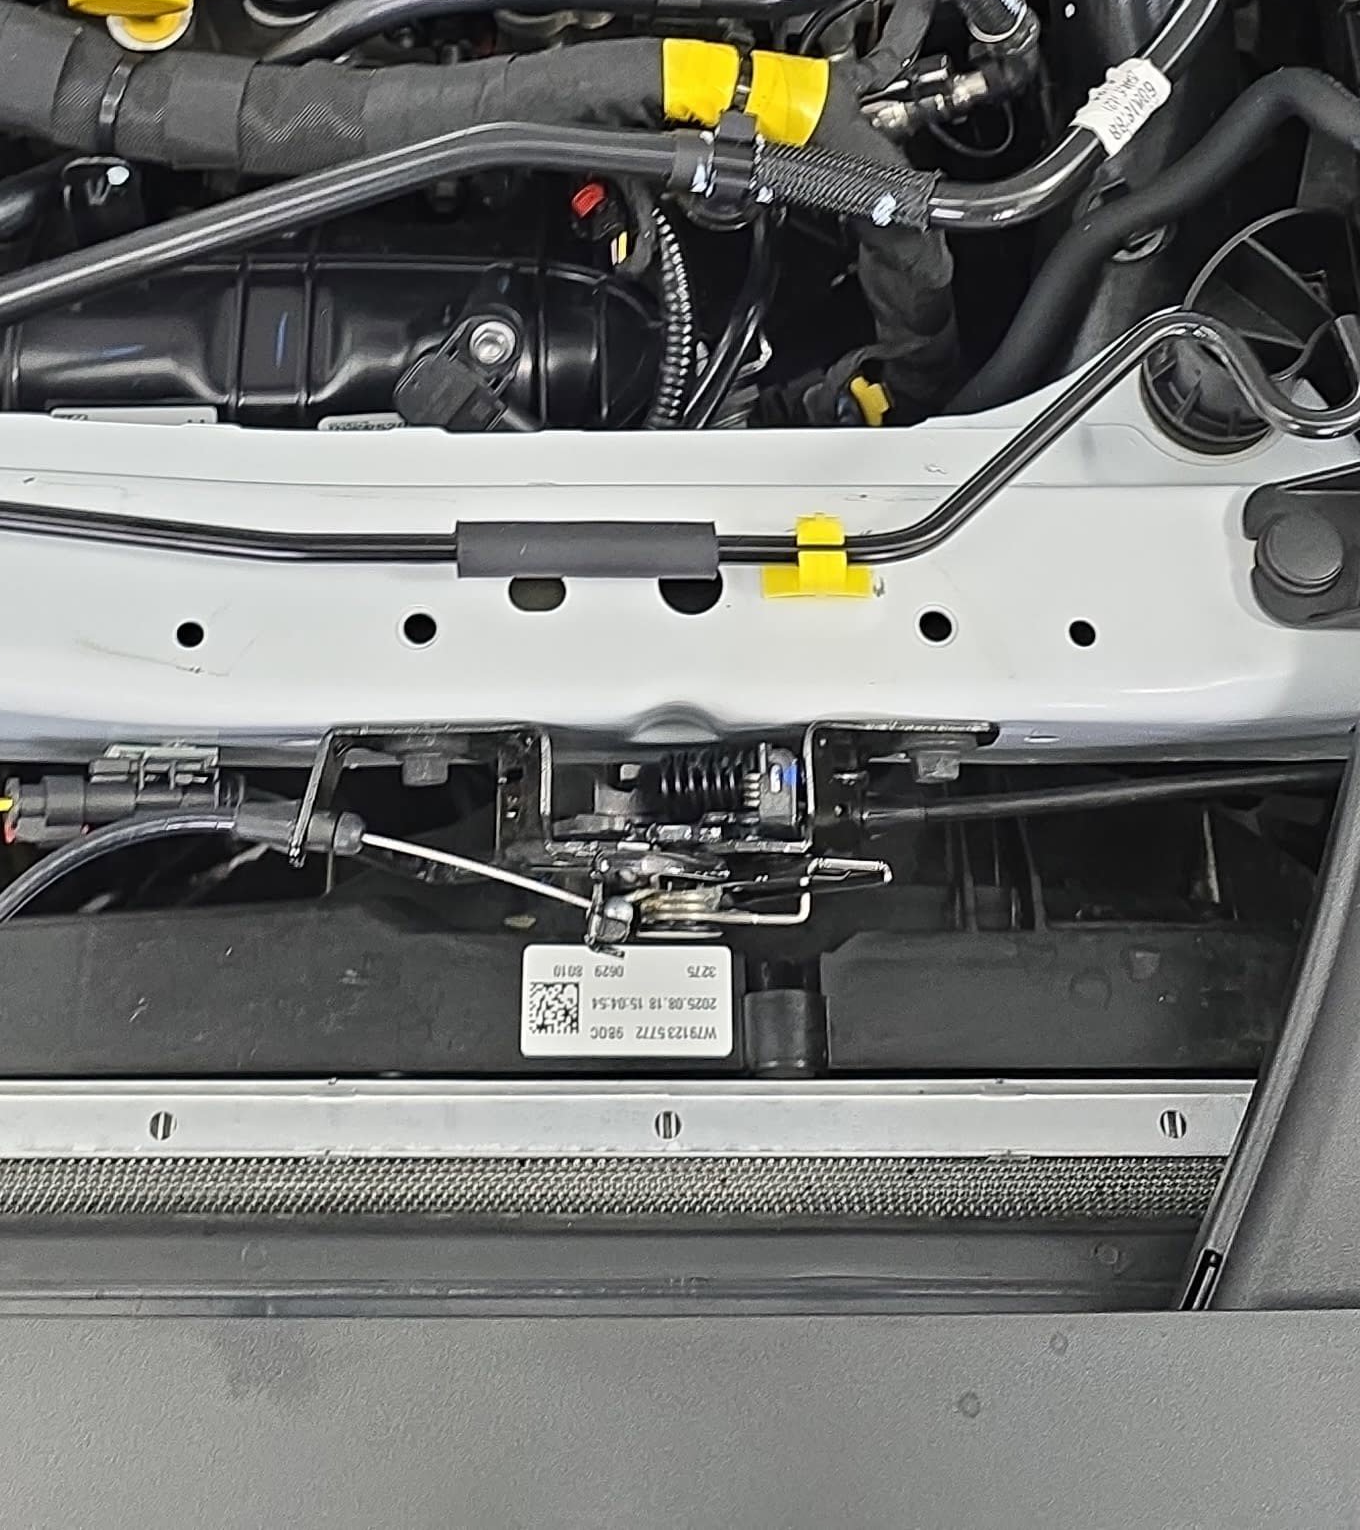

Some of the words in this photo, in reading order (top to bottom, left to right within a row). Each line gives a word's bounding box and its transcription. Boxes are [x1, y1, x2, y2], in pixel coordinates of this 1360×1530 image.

[553, 964, 583, 977] 8010
[594, 964, 624, 977] 0629
[687, 965, 716, 978] 3275
[592, 996, 643, 1010] 15:04:54
[649, 997, 716, 1010] 2025.08.18
